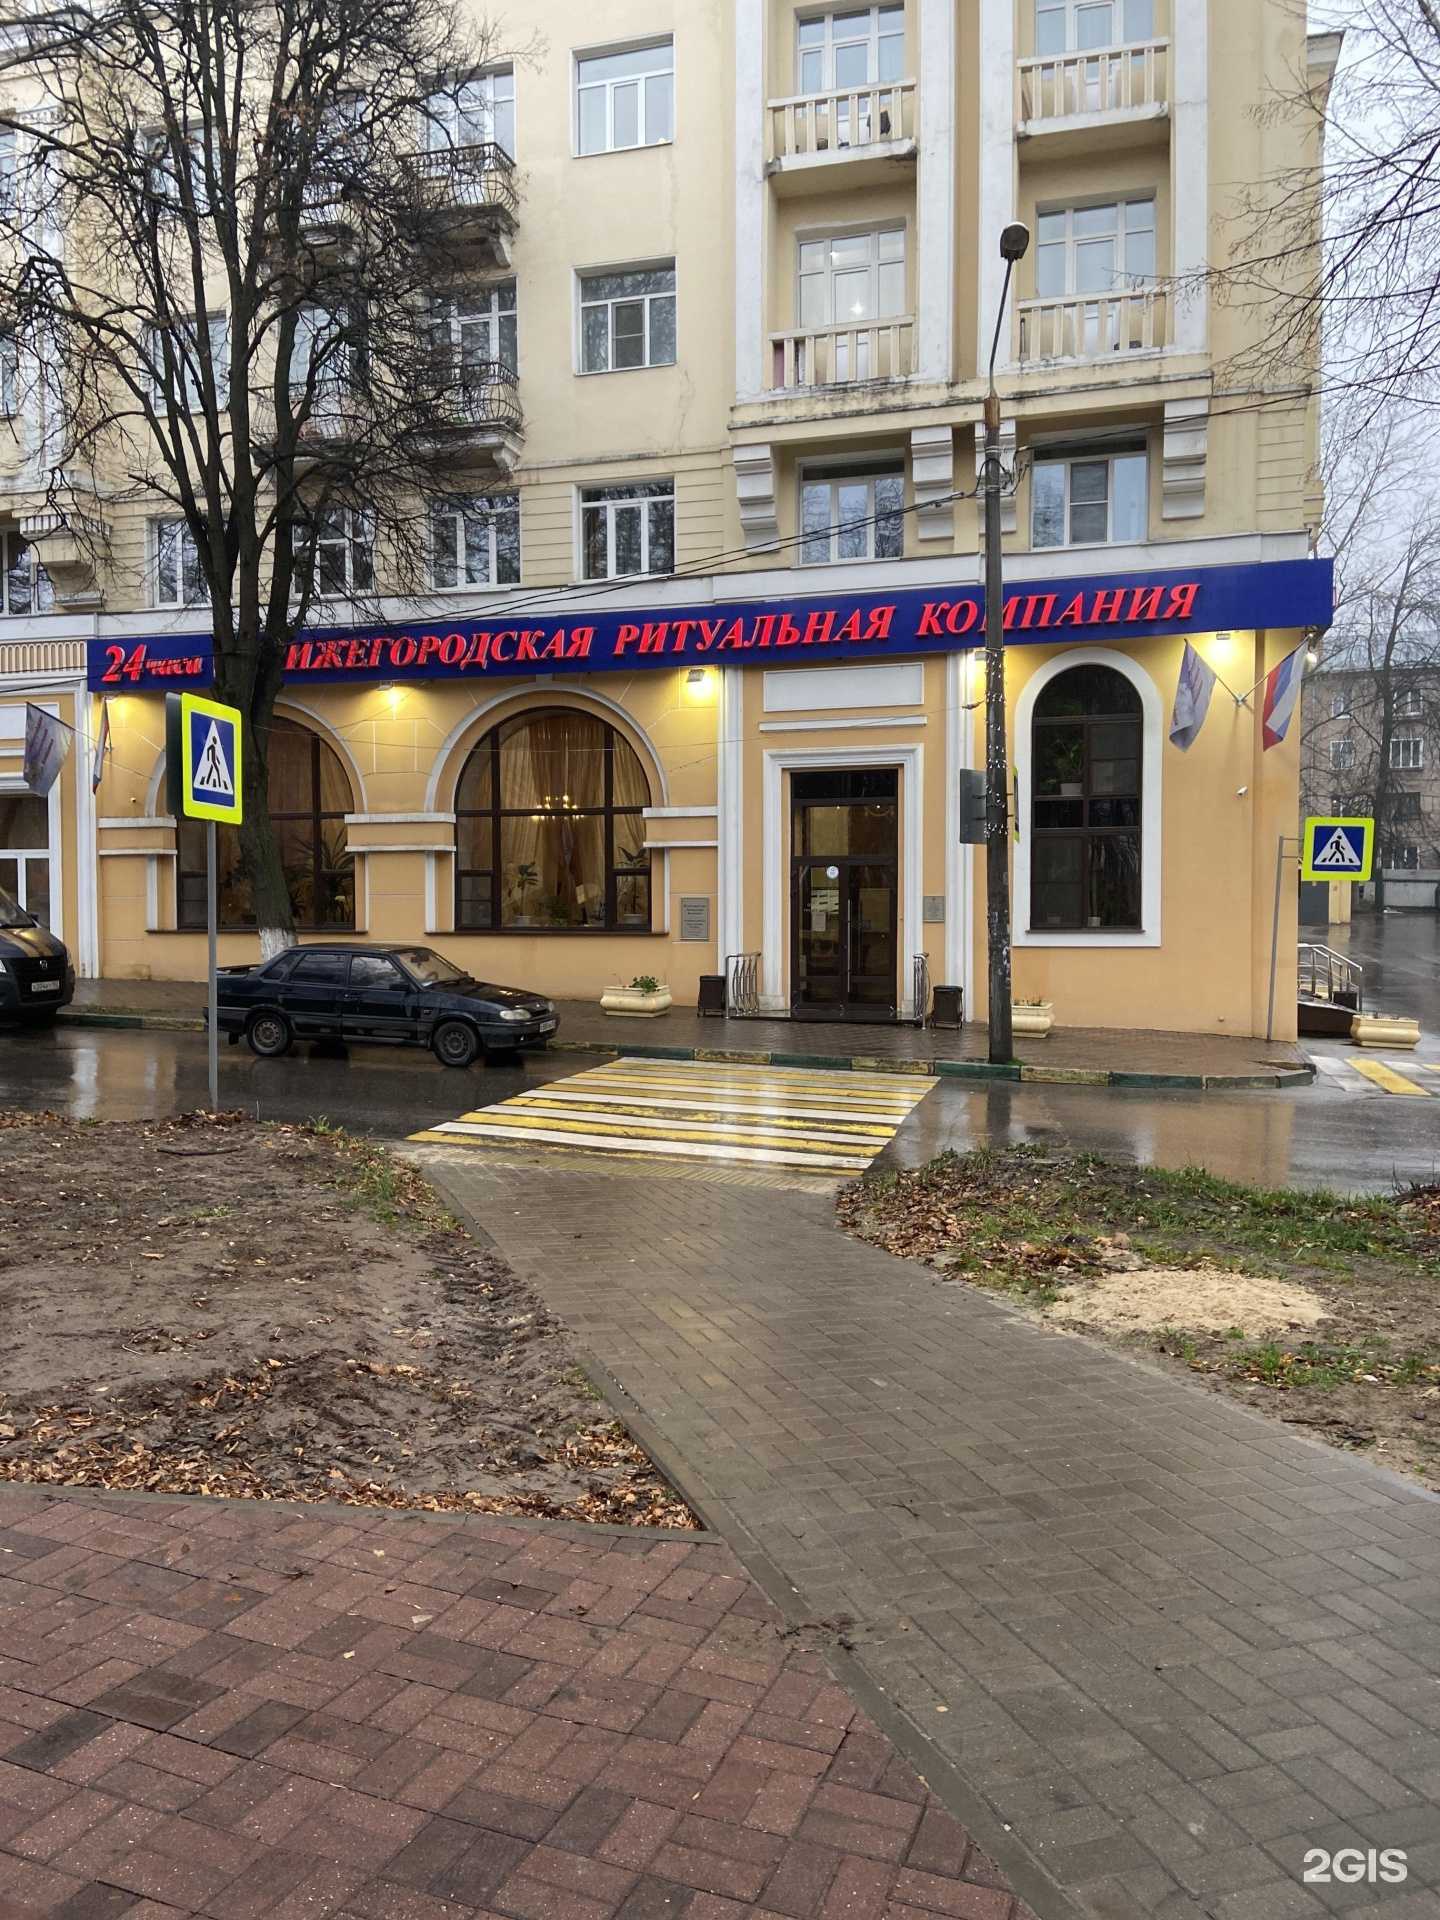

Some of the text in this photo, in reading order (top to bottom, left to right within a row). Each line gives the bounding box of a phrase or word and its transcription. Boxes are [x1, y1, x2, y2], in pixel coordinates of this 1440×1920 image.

[284, 583, 1200, 670] ИЖЕГОРОДСКАЯ РИТУАЛЬНАЯ КОМПАНИЯ
[102, 644, 147, 682] 24
